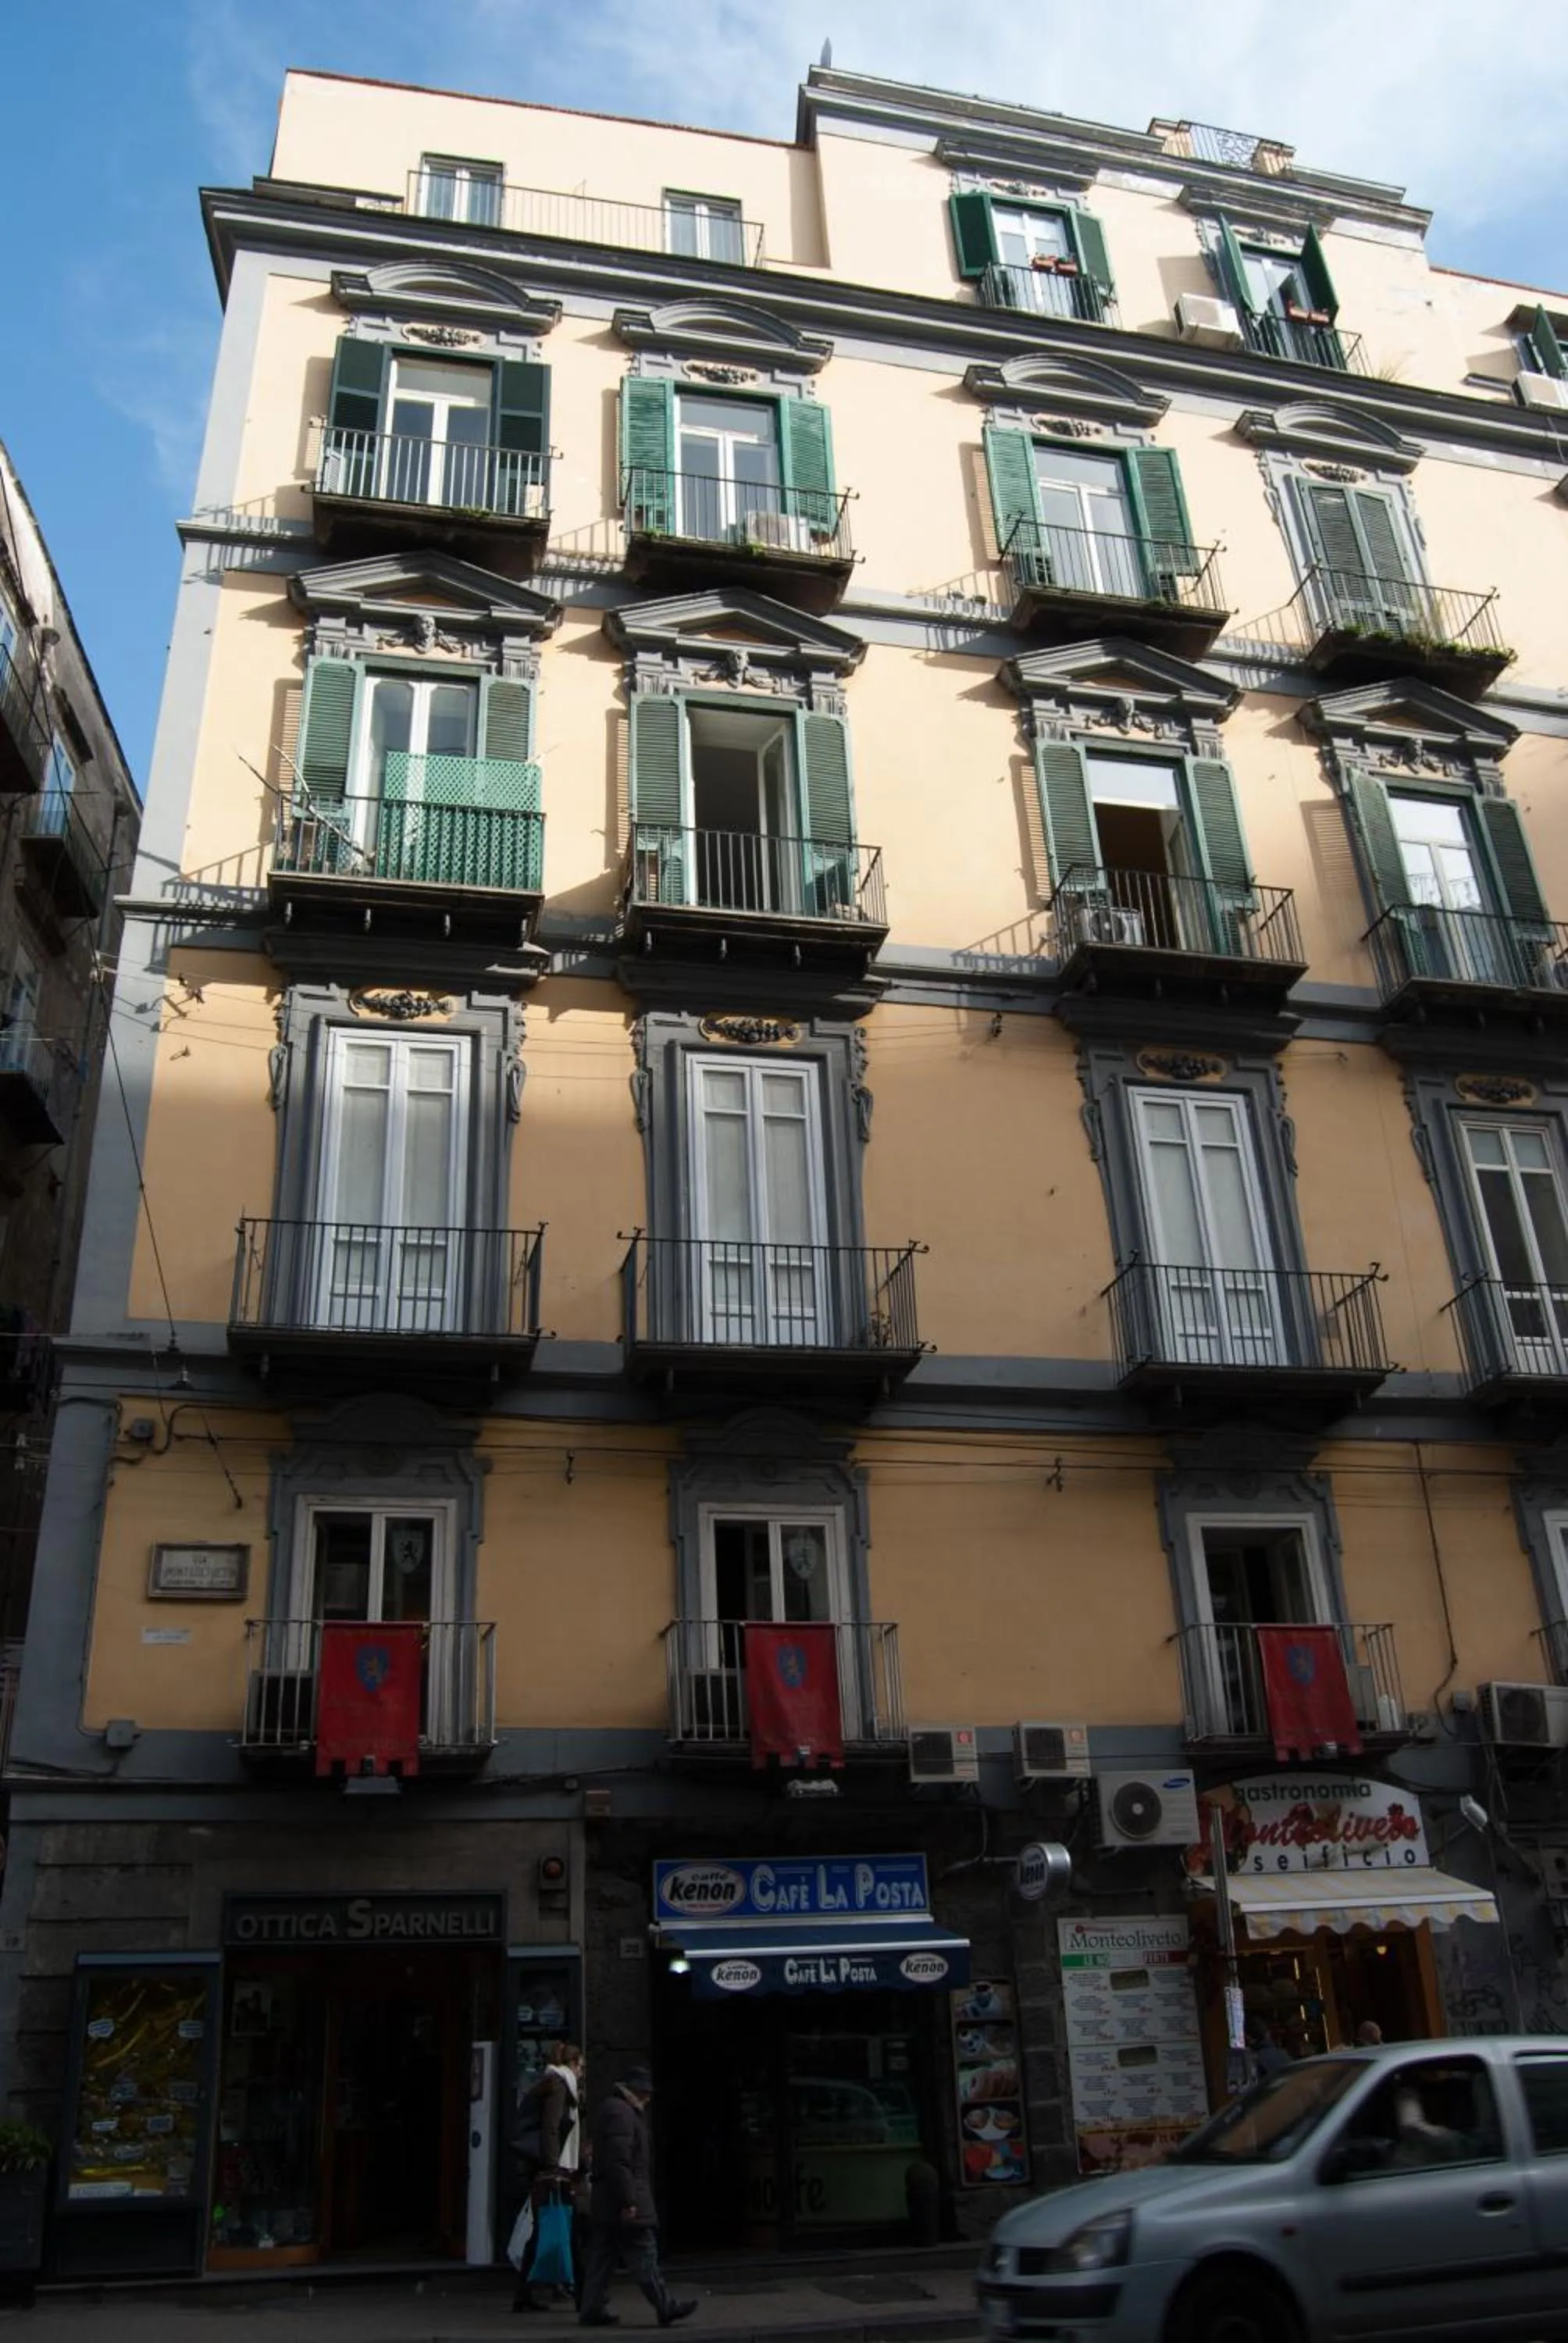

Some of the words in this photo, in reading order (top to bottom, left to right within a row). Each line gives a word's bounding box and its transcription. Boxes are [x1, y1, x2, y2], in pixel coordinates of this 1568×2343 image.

[669, 1877, 736, 1901] kenon
[817, 1863, 848, 1910] LA
[854, 1863, 925, 1910] POSTA
[236, 1913, 337, 1938] OTTICA
[347, 1899, 495, 1938] SPARNELLI
[1070, 1931, 1181, 1949] Monteoliveto
[839, 1956, 878, 1983] POSTA
